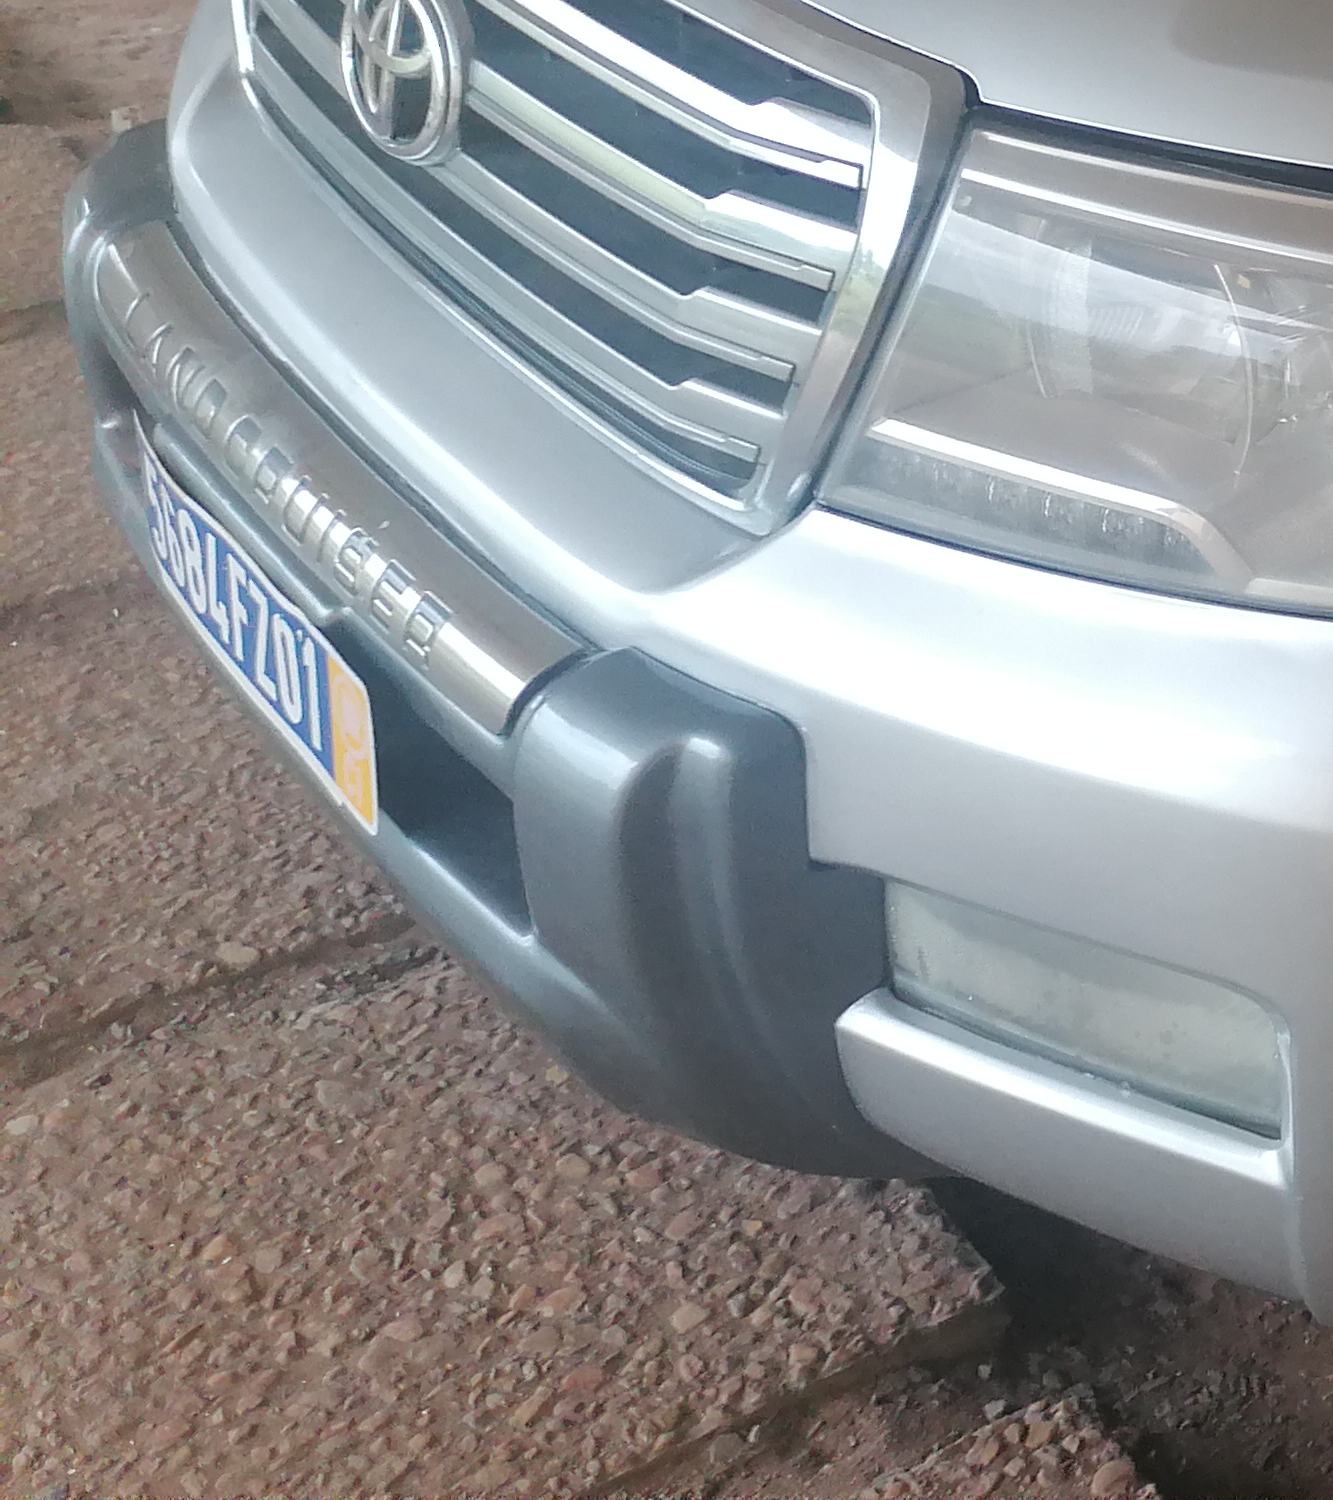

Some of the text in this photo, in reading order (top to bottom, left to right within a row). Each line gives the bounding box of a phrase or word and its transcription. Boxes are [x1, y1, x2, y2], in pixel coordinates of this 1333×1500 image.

[125, 292, 454, 670] LAND CRUISER
[144, 452, 322, 752] 5684FZ01
